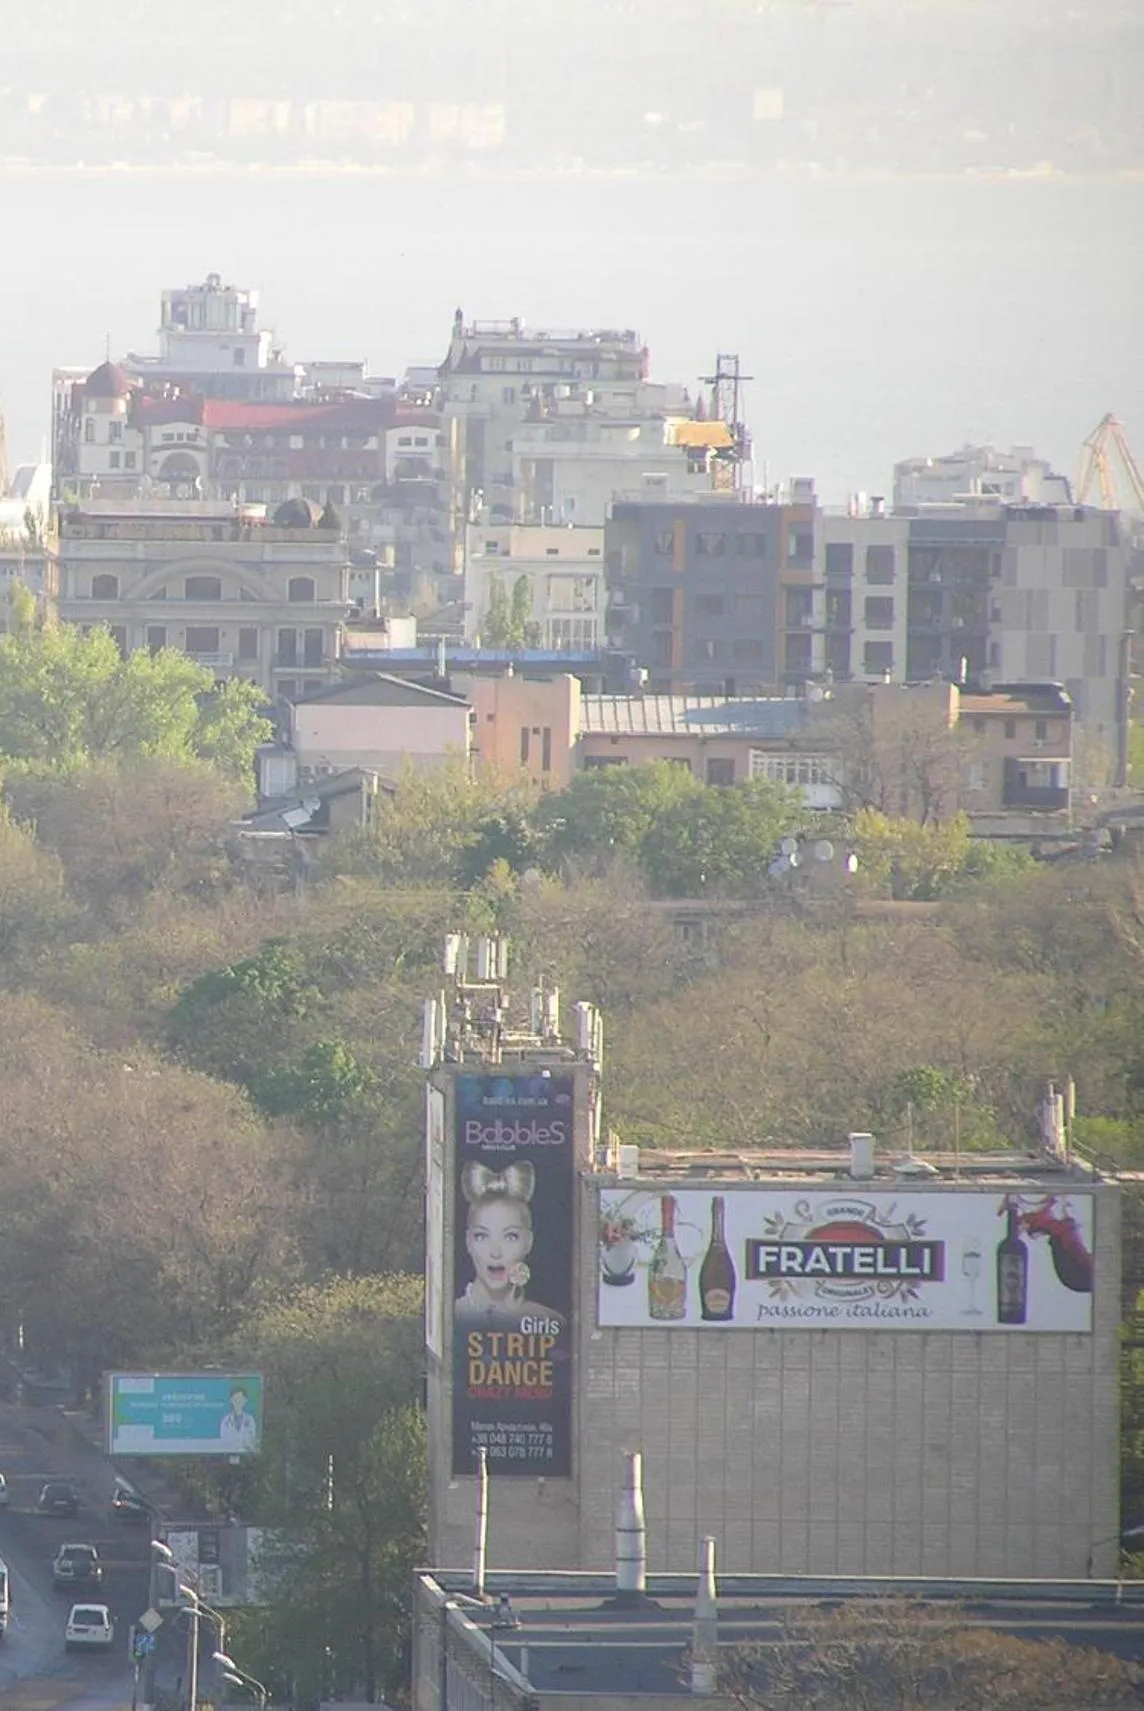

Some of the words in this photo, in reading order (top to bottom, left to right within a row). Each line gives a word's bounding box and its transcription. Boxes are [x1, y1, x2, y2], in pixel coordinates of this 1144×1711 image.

[759, 1248, 931, 1274] FRATELLI
[758, 1304, 839, 1320] passione
[847, 1303, 930, 1317] italiana
[521, 1317, 559, 1334] Girls
[468, 1332, 555, 1357] STRIP
[470, 1361, 553, 1385] DANCE
